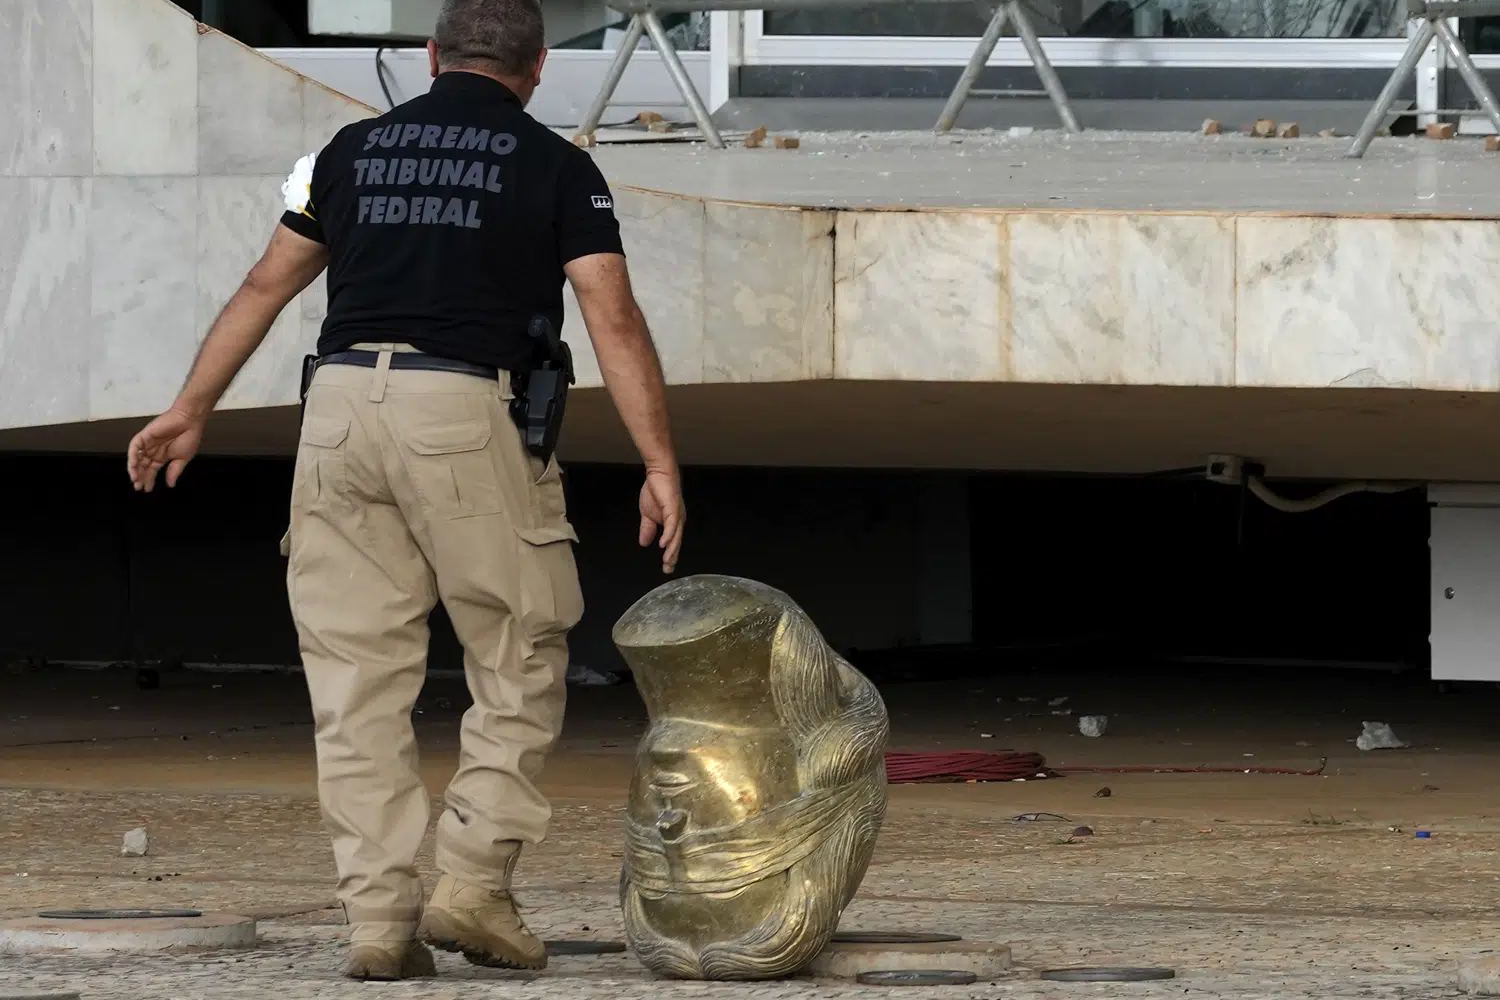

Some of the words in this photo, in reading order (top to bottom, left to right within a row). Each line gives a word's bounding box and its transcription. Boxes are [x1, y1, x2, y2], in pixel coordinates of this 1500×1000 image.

[363, 123, 518, 156] SUPREMO
[354, 157, 503, 194] TRIBUNAL
[357, 196, 484, 229] FEDERAL
